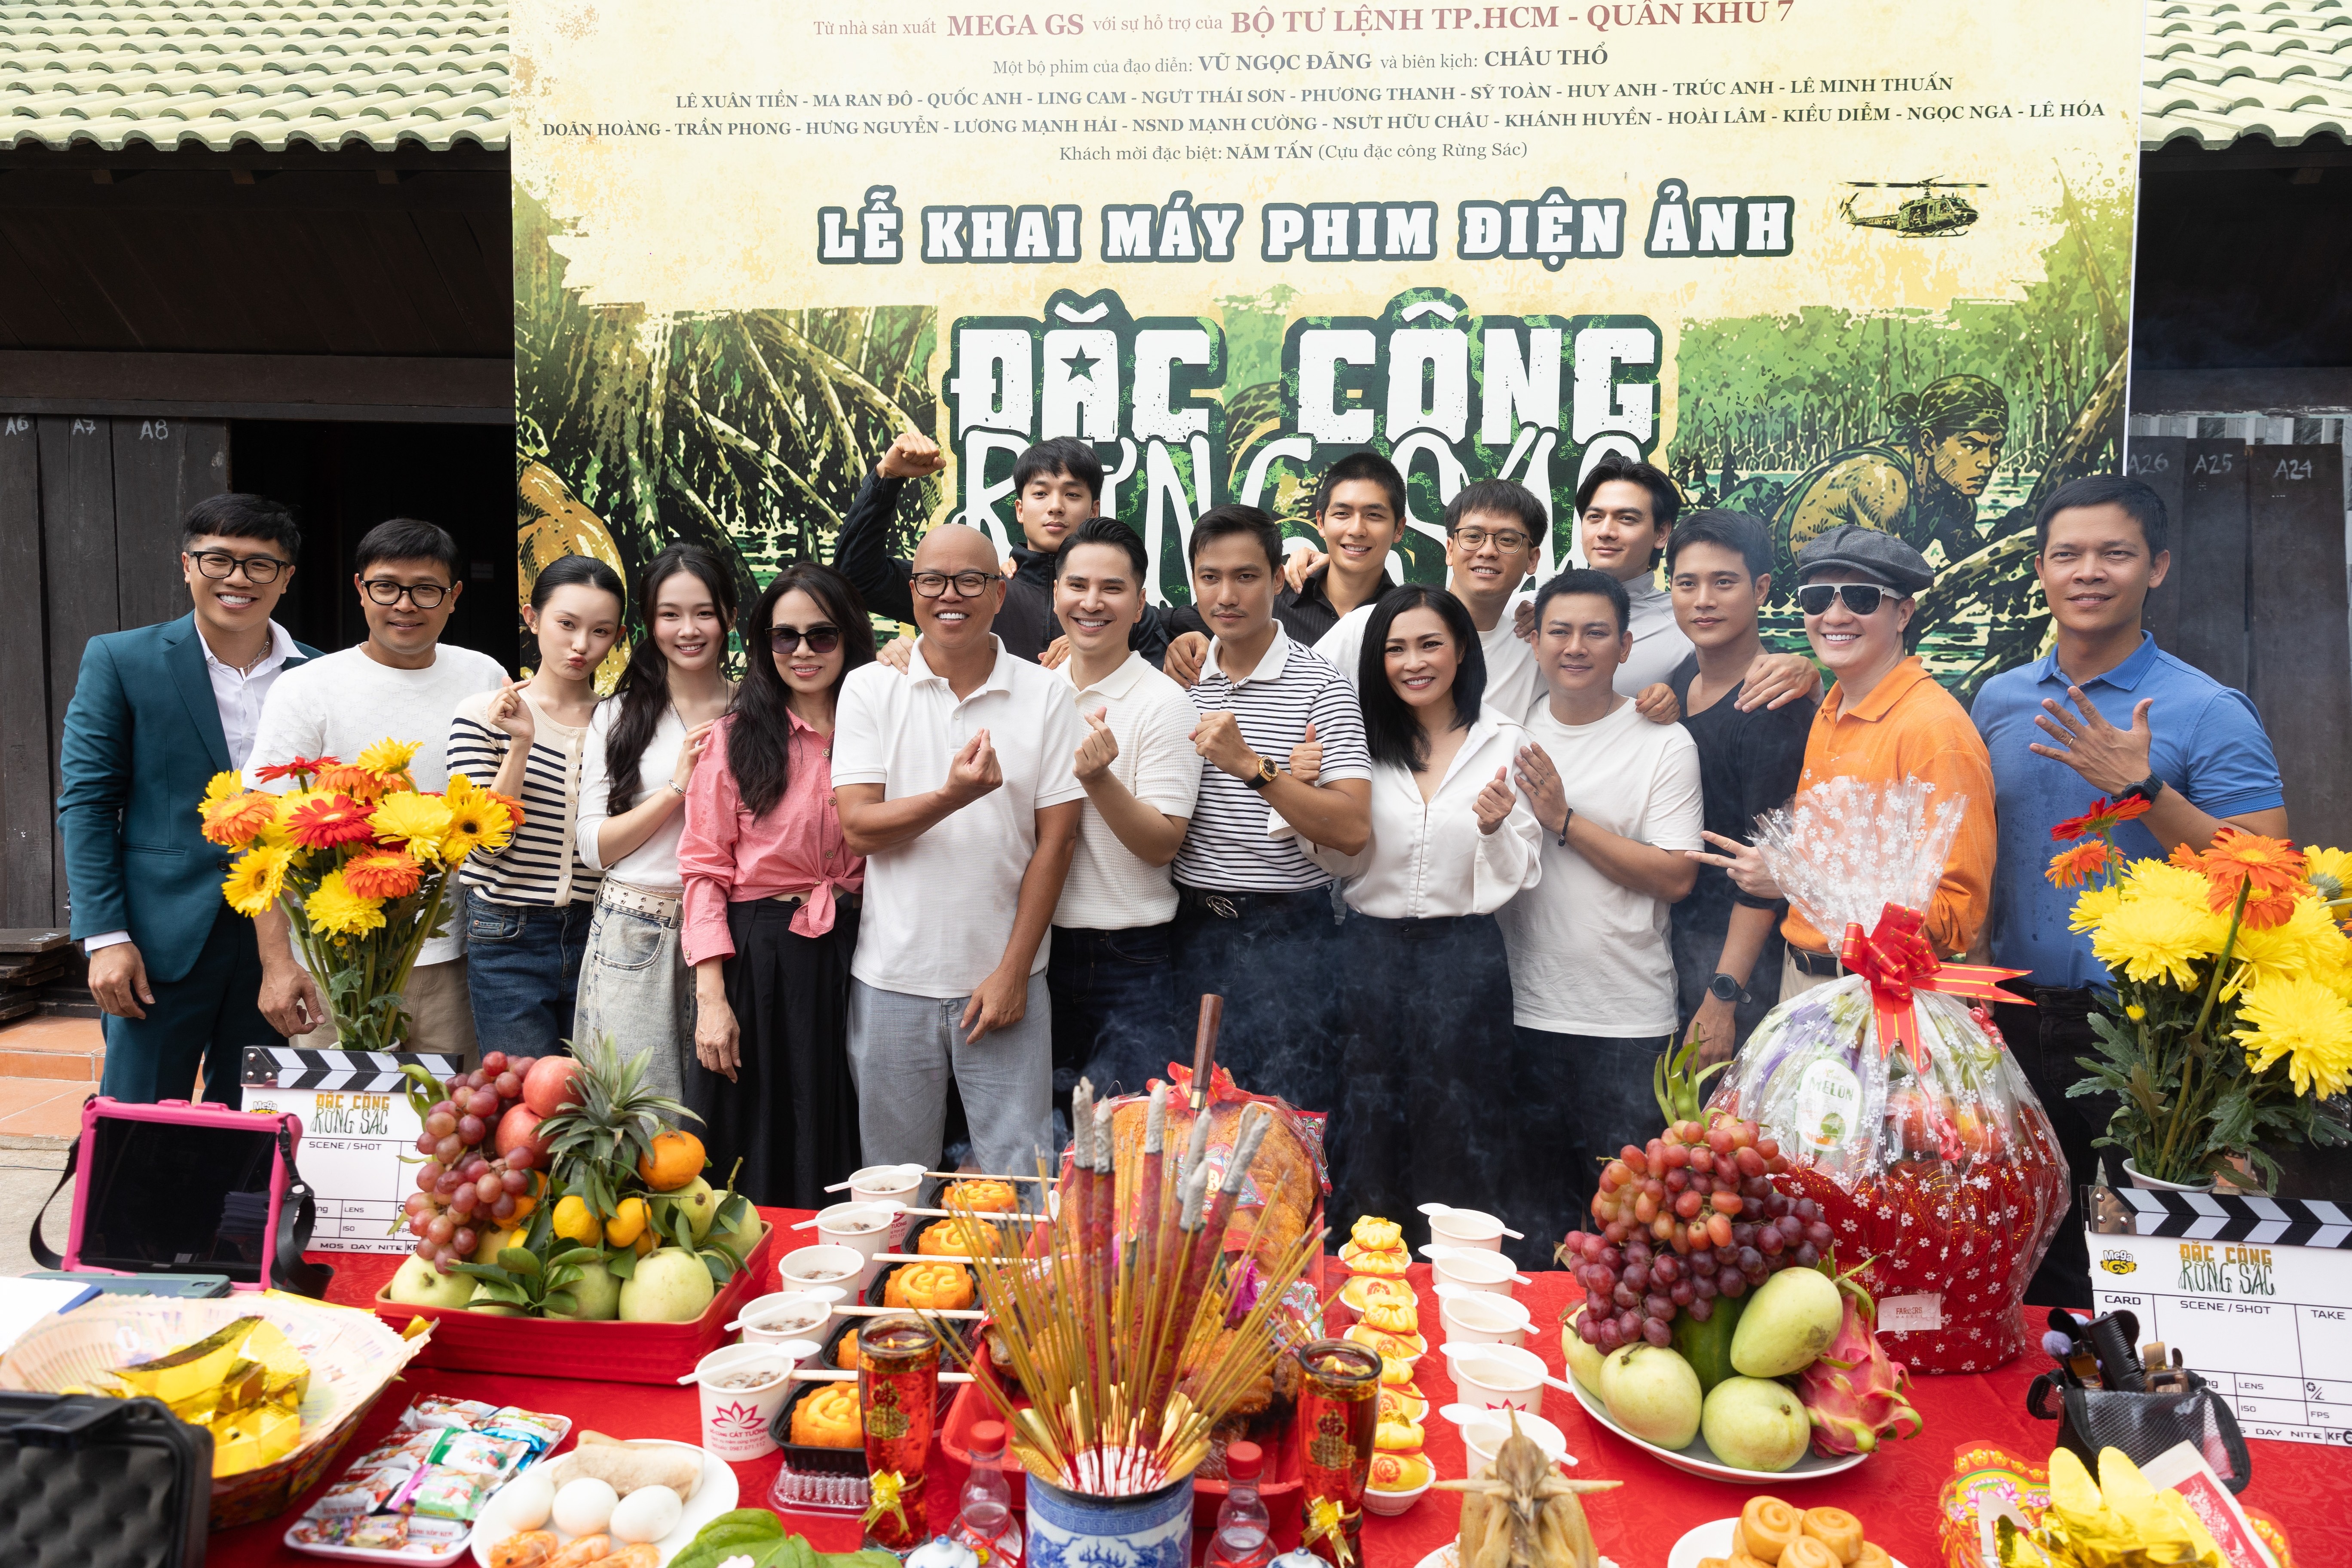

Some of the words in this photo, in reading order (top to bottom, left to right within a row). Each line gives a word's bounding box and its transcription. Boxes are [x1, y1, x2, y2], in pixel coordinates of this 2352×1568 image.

[813, 21, 835, 35] Từ
[838, 19, 868, 35] nhà
[872, 20, 899, 35] sản
[902, 17, 937, 34] xuất
[946, 14, 1039, 37] MEGA
[1044, 13, 1084, 36] GS
[1092, 15, 1117, 31] với
[1121, 18, 1139, 31] sự
[1143, 13, 1164, 31] hỗ
[1167, 16, 1191, 30] trợ
[1195, 14, 1223, 30] của
[1230, 5, 1275, 39] BỘ
[1282, 6, 1326, 33] TƯ
[1332, 3, 1424, 37] LỆNH
[1431, 6, 1560, 30] TP.HCM
[1586, 0, 1684, 33] QUÂN
[1691, 0, 1770, 24] KHU
[1777, 0, 1795, 22] 7
[992, 60, 1023, 74] Một
[1026, 59, 1046, 74] bộ
[1049, 58, 1089, 77] phim
[1093, 59, 1120, 74] của
[1123, 58, 1151, 73] đạo
[1155, 56, 1193, 73] diễn:
[1197, 52, 1231, 72] VŨ
[1235, 54, 1301, 74] NGỌC
[1305, 50, 1373, 70] ĐÃNG
[1379, 55, 1398, 69] và
[1401, 54, 1436, 69] biên
[1439, 52, 1478, 68] kịch:
[1484, 46, 1553, 67] CHÂU
[1556, 40, 1608, 66] THỔ
[675, 92, 698, 108] LÊ
[701, 91, 753, 108] XUÂN
[755, 89, 799, 108] TIỀN
[812, 94, 842, 107] MA
[844, 93, 883, 107] RAN
[886, 89, 913, 107] ĐÔ
[927, 86, 979, 109] QUỐC
[981, 92, 1023, 106] ANH
[1037, 91, 1083, 105] LING
[1086, 91, 1127, 105] CAM
[1141, 88, 1194, 104] NGƯT
[1196, 86, 1243, 104] THÁI
[1247, 88, 1286, 103] SƠN
[1300, 86, 1383, 102] PHƯƠNG
[1386, 86, 1456, 101] THANH
[1470, 83, 1496, 100] SỸ
[1498, 81, 1553, 99] TOÀN
[1566, 84, 1611, 98] HUY
[1612, 83, 1658, 97] ANH
[1672, 78, 1726, 96] TRÚC
[1729, 80, 1775, 95] ANH
[1789, 76, 1816, 94] LÊ
[1819, 78, 1877, 93] MINH
[1880, 70, 1954, 92] THUẤN
[542, 121, 593, 136] DOÃN
[597, 122, 662, 136] HOÀNG
[674, 116, 724, 136] TRẦN
[726, 122, 792, 136] PHONG
[805, 119, 860, 135] HƯNG
[862, 114, 940, 135] NGUYỄN
[953, 118, 1018, 134] LƯƠNG
[1021, 119, 1079, 136] MẠNH
[1083, 115, 1118, 132] HẢI
[1131, 118, 1184, 132] NSND
[1188, 118, 1247, 135] MẠNH
[1251, 113, 1318, 131] CƯỜNG
[1332, 114, 1383, 130] NSƯT
[1386, 113, 1431, 129] HỮU
[1434, 111, 1490, 129] CHÂU
[1504, 109, 1578, 128] KHÁNH
[1581, 105, 1653, 126] HUYỀN
[1667, 107, 1719, 125] HOÀI
[1723, 106, 1767, 124] LÂM
[1782, 102, 1833, 123] KIỀU
[1836, 101, 1891, 122] DIỄM
[1906, 105, 1965, 123] NGỌC
[1968, 104, 2014, 119] NGA
[2028, 100, 2055, 118] LÊ
[2058, 99, 2106, 117] HÓA
[1059, 145, 1112, 161] Khách
[1115, 145, 1148, 160] mời
[1152, 145, 1182, 160] đặc
[1185, 145, 1222, 162] biệt:
[1225, 143, 1271, 160] NĂM
[1274, 139, 1314, 159] TẤN
[1318, 144, 1359, 161] (Cựu
[1363, 143, 1393, 158] đặc
[1396, 144, 1437, 161] công
[1441, 143, 1487, 160] Rừng
[1491, 141, 1528, 159] Sác)
[820, 188, 900, 261] LỄ
[924, 208, 1078, 260] KHAI
[1105, 194, 1240, 259] MÁY
[1265, 199, 1434, 258] PHIM
[1461, 191, 1623, 268] ĐIỆN
[1649, 181, 1790, 254] ẢNH
[1296, 299, 1656, 445] CÔNG
[5, 414, 29, 437] A6
[72, 418, 96, 436] A7
[139, 419, 168, 440] A8
[2127, 452, 2169, 475] A26
[2193, 453, 2233, 475] A25
[2273, 458, 2313, 481] A24
[1809, 1076, 1854, 1101] MELON
[254, 1101, 277, 1111] Mega
[353, 1092, 390, 1110] CÔNG
[359, 1108, 389, 1135] SÁC
[309, 1141, 345, 1149] SCENE
[2103, 1249, 2133, 1262] Mega
[2225, 1243, 2272, 1266] CÔNG
[2107, 1260, 2129, 1275] GS
[2178, 1258, 2233, 1293] RỪNG
[2239, 1262, 2276, 1296] SÁC
[2104, 1295, 2141, 1305] CARD
[2180, 1300, 2225, 1312] SCENE
[2236, 1304, 2271, 1315] SHOT
[2310, 1309, 2346, 1320] TAKE
[2238, 1382, 2264, 1390] LENS
[2310, 1411, 2330, 1419] FPS
[744, 1426, 769, 1436] TƯỜNG
[2255, 1428, 2283, 1436] DAY
[2290, 1430, 2323, 1439] NITE
